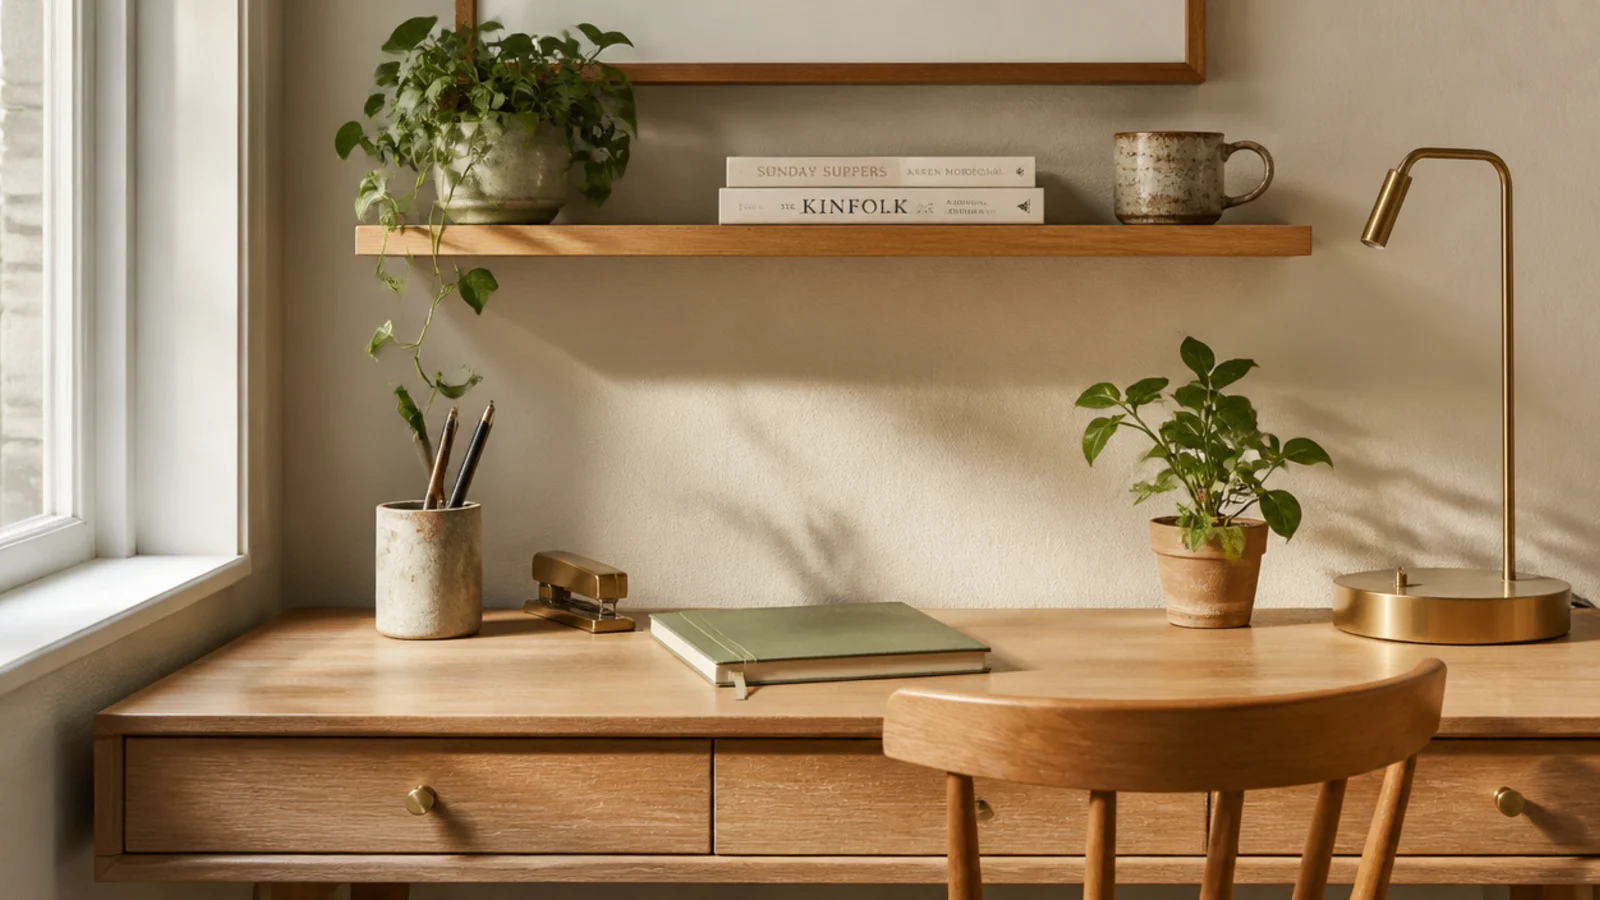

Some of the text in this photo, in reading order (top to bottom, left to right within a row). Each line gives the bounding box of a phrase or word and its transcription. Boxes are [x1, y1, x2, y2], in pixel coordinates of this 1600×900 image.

[757, 166, 888, 177] SUNDAY SUPPERS
[802, 198, 908, 214] KINFOLK
